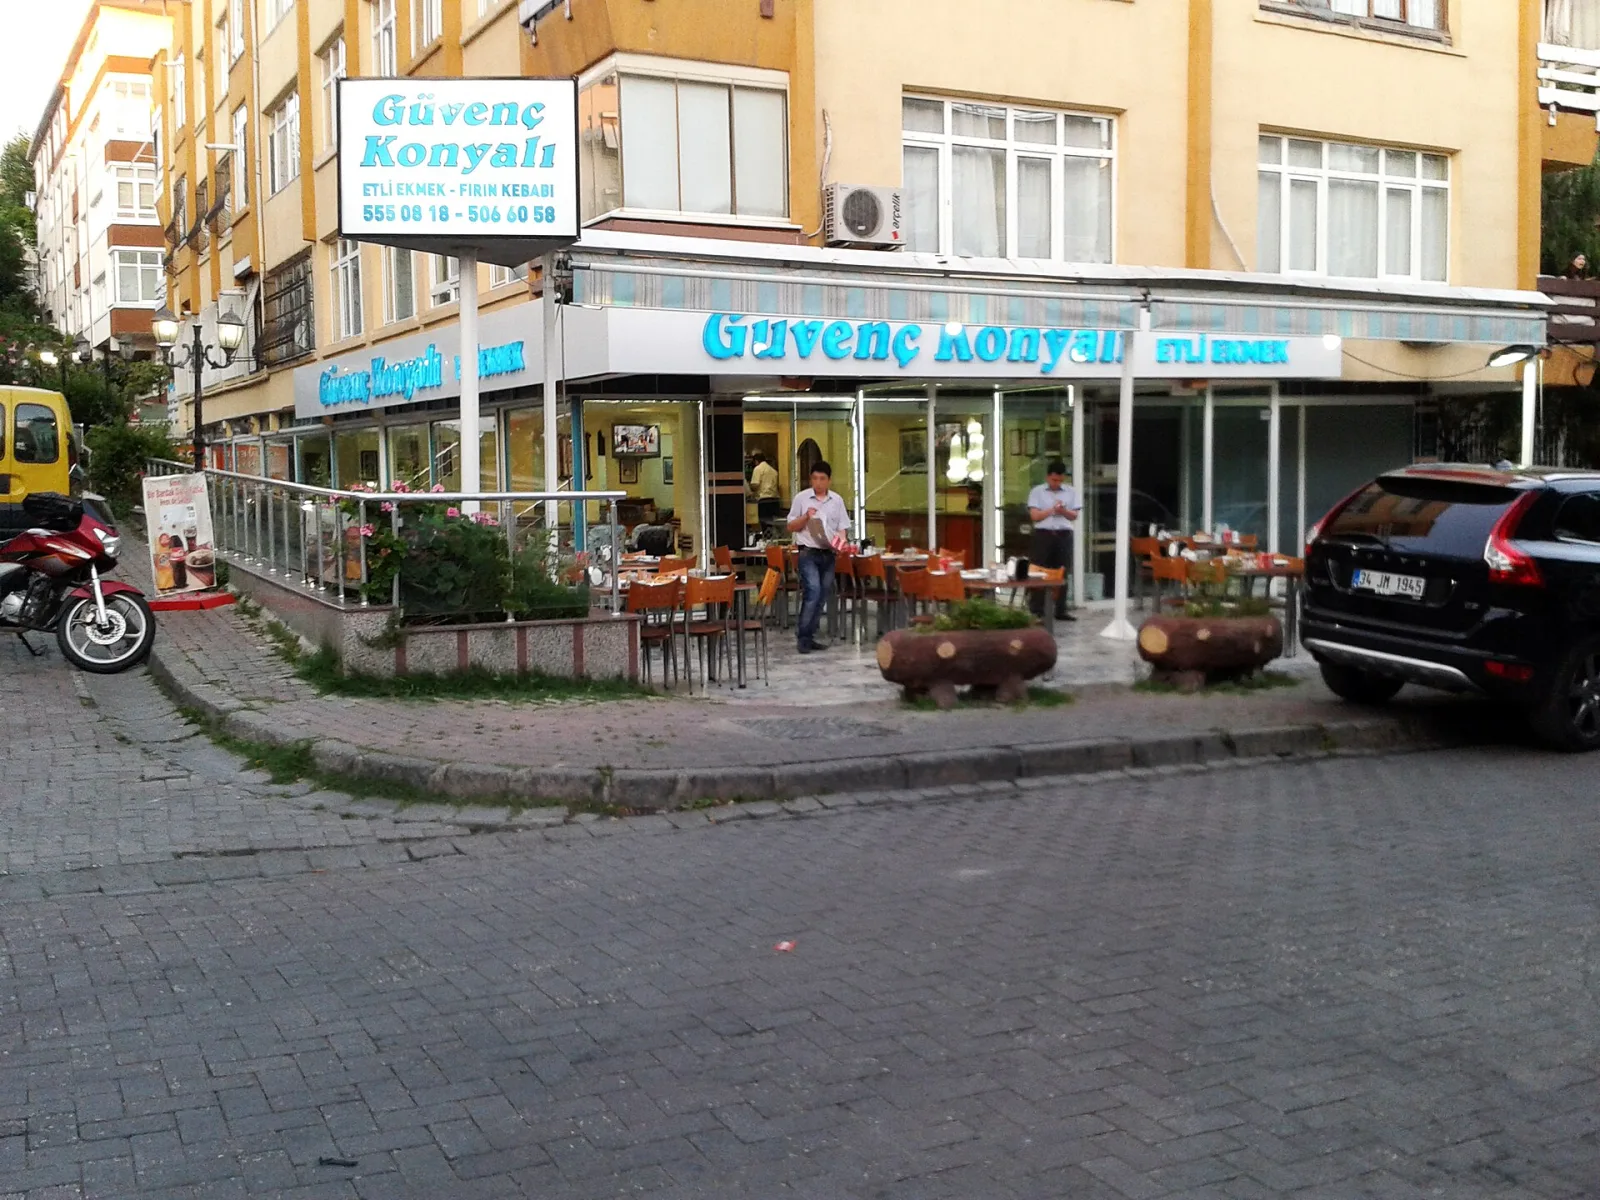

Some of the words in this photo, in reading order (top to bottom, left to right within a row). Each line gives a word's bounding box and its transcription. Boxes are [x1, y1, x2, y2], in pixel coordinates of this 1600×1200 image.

[372, 93, 546, 130] Güvenç
[360, 135, 556, 175] Konyalı
[363, 180, 392, 197] ETLİ
[397, 183, 446, 197] EKMEK
[460, 183, 497, 197] FIRIN
[502, 184, 554, 198] KEBABI
[363, 205, 396, 222] 555
[401, 205, 422, 222] 08
[429, 205, 449, 222] 18
[468, 206, 501, 223] 506
[507, 206, 528, 223] 60
[533, 206, 556, 223] 58
[1211, 340, 1290, 363] EKMEK
[1359, 572, 1371, 586] 34
[1377, 572, 1390, 590] JM
[1397, 577, 1422, 594] 1945
